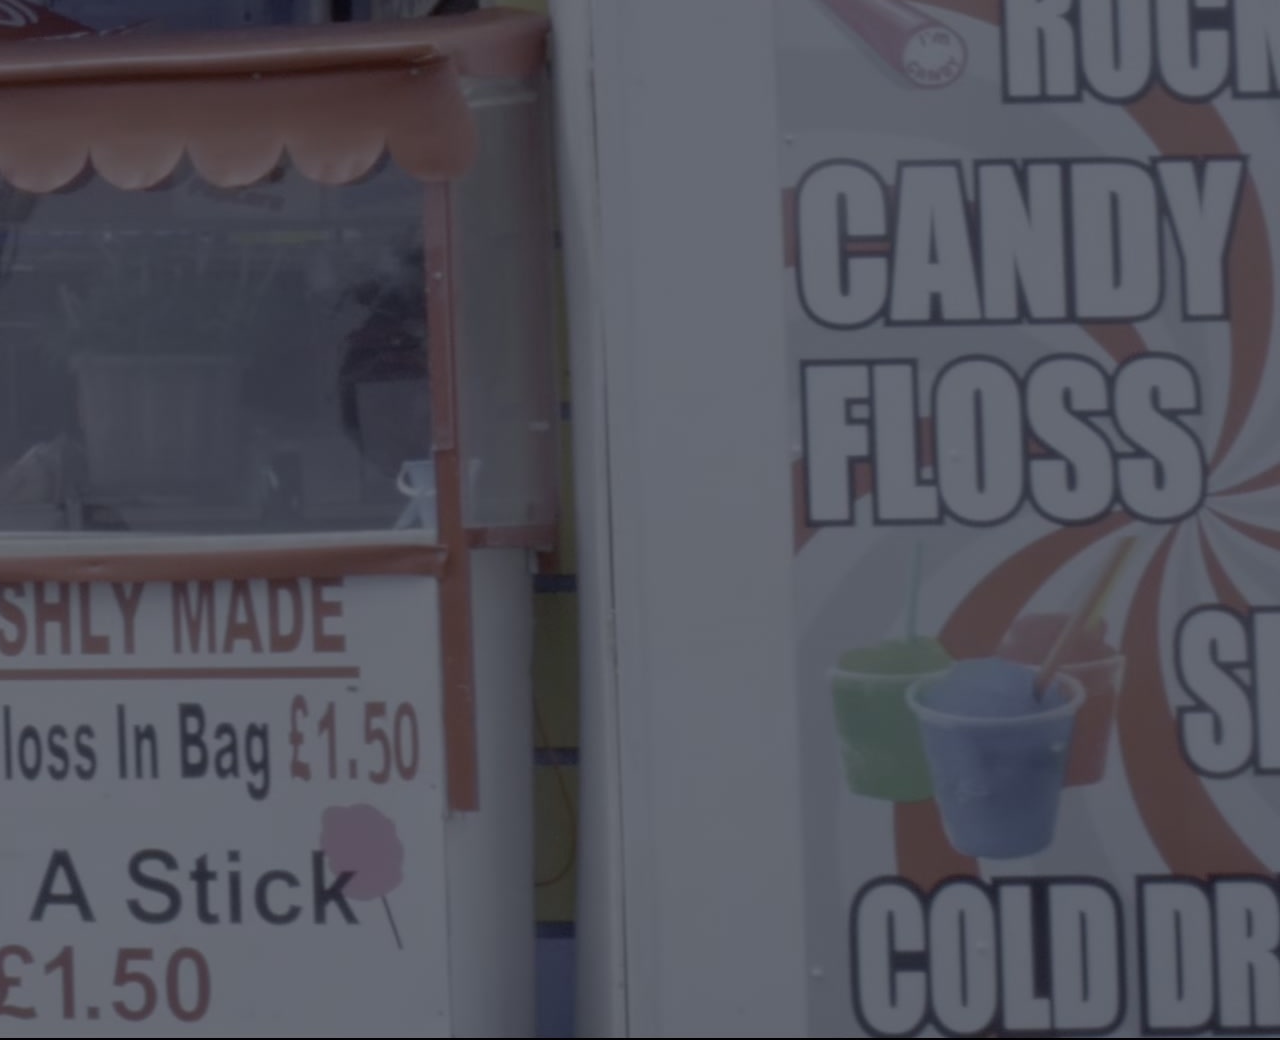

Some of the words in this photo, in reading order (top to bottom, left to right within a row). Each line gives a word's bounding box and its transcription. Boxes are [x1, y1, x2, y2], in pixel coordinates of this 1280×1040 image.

[794, 154, 1250, 330] CANDY
[799, 351, 1208, 529] FLOSS
[171, 576, 347, 654] MADE
[116, 703, 160, 780] In
[178, 701, 271, 802] Bag
[288, 693, 420, 785] £1.50
[29, 848, 97, 923] A
[125, 847, 360, 926] Stick
[849, 873, 1127, 1038] COLD
